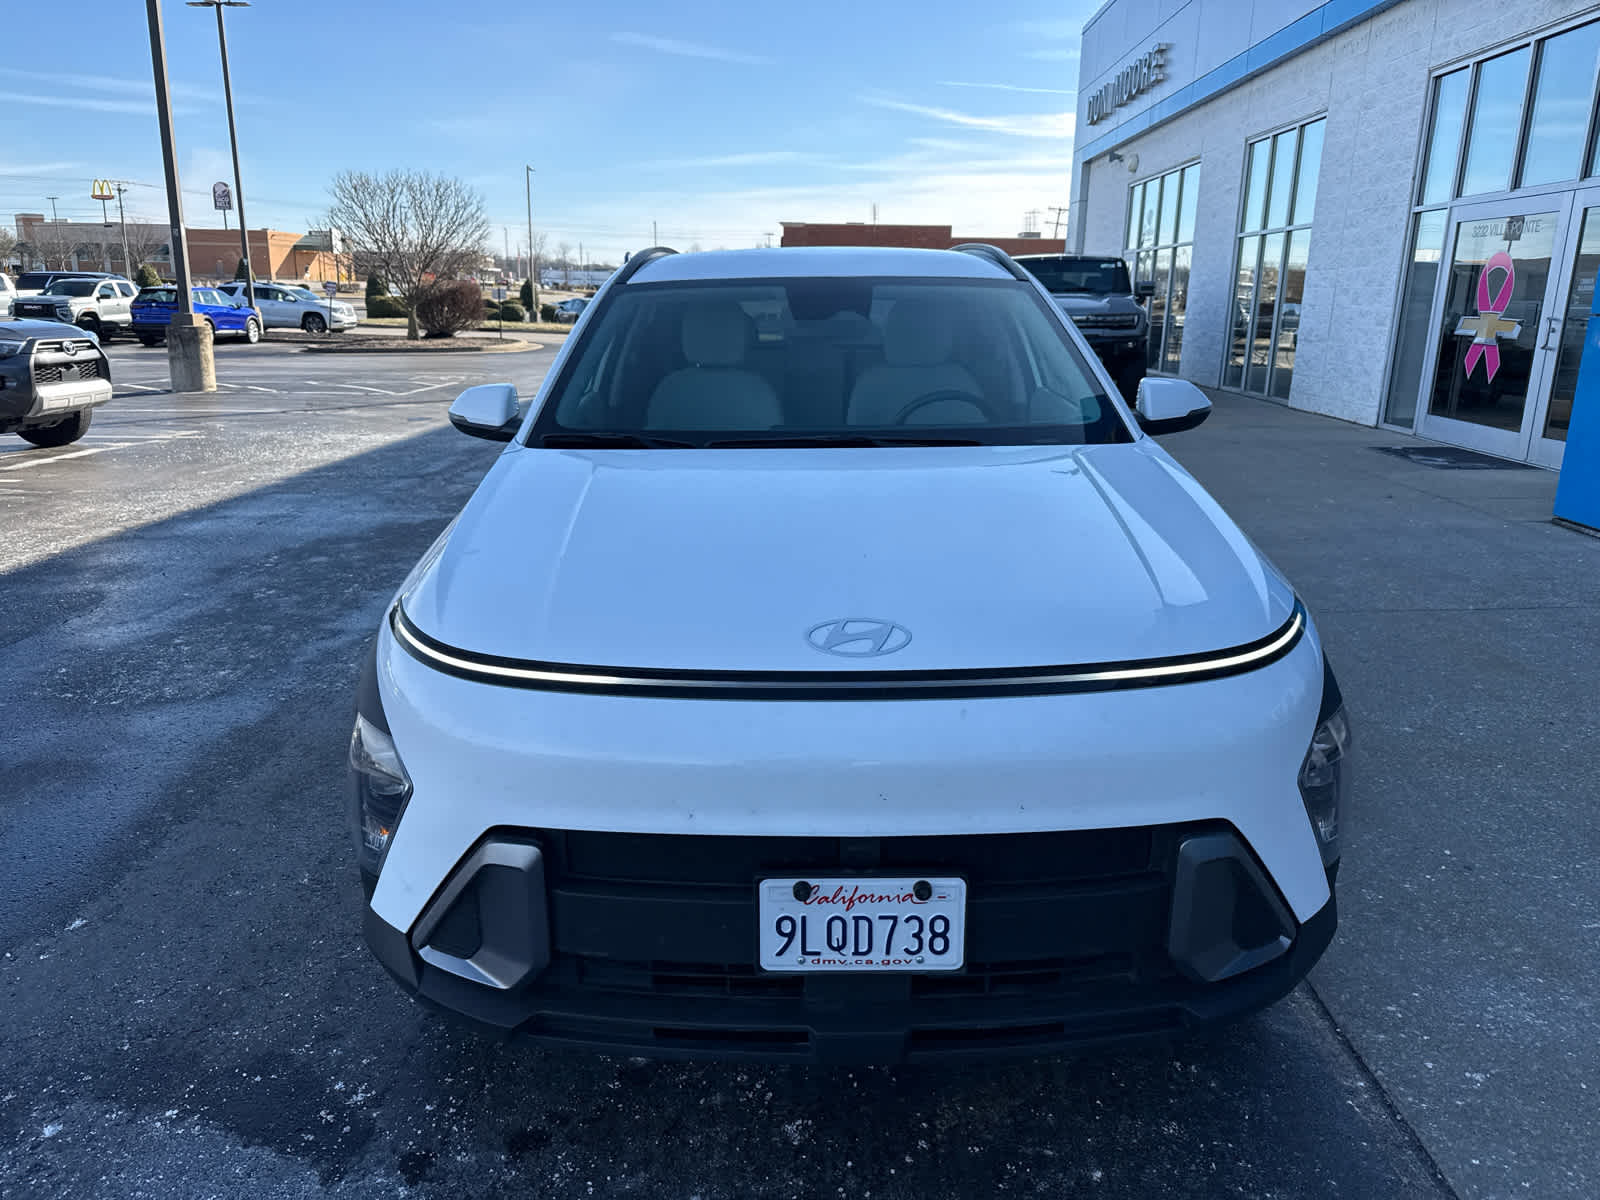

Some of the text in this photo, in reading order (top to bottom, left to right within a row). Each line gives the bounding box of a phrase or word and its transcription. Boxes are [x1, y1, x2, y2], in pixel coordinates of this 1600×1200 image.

[1111, 43, 1168, 107] MOORE
[803, 884, 928, 911] California
[775, 915, 950, 956] 9LQD738
[811, 957, 913, 966] dmv.ca.gov
